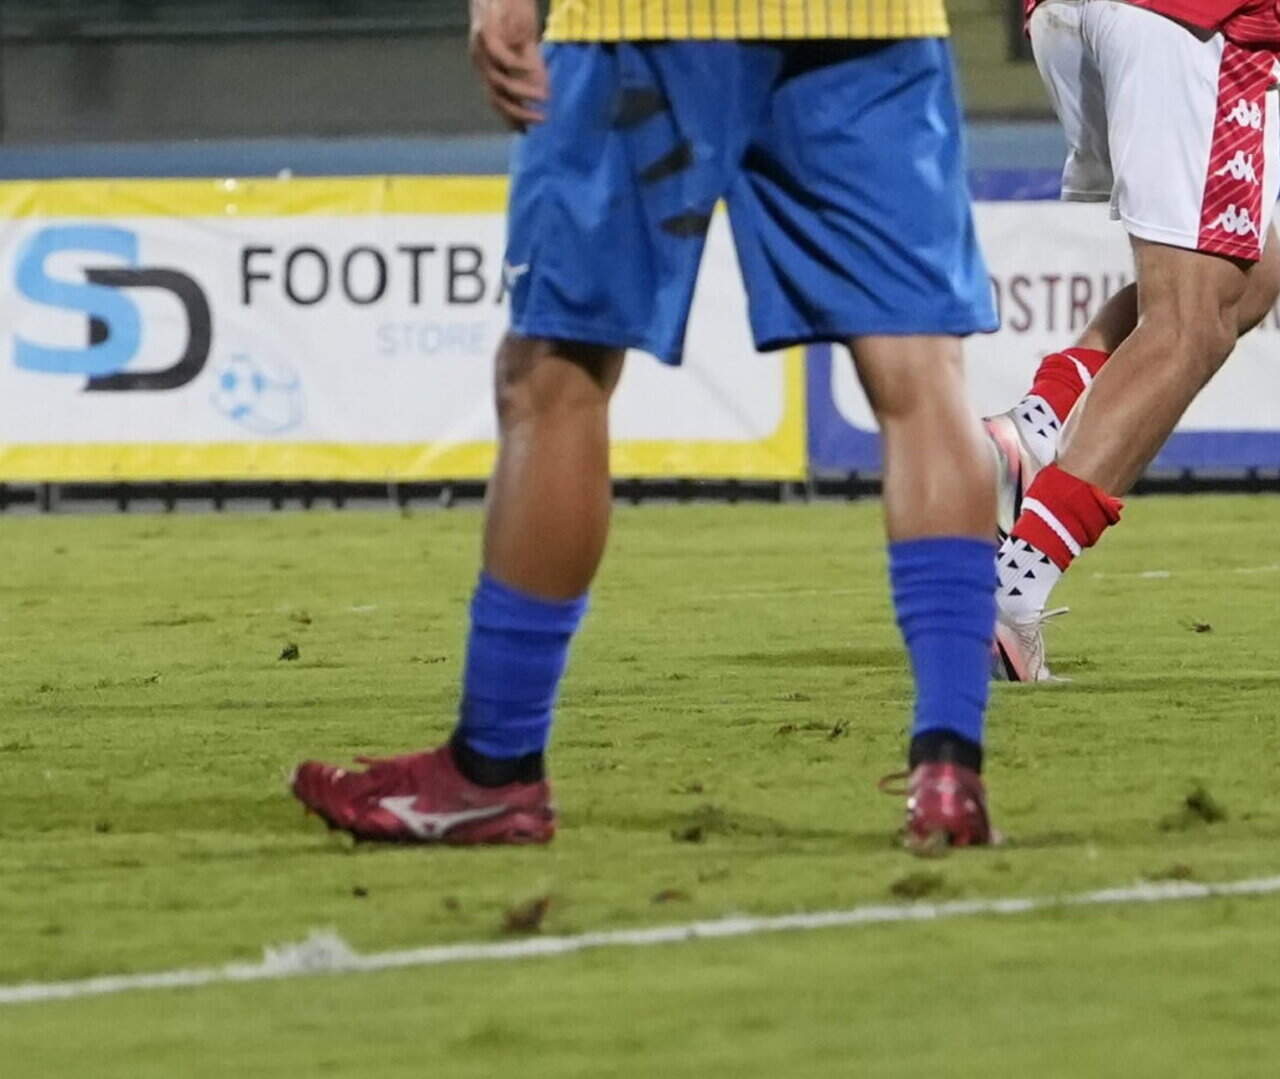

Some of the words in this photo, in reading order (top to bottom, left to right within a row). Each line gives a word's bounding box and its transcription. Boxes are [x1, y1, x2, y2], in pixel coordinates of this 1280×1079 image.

[240, 244, 502, 306] FOOTB
[13, 225, 212, 391] SD
[377, 323, 488, 356] STORE
